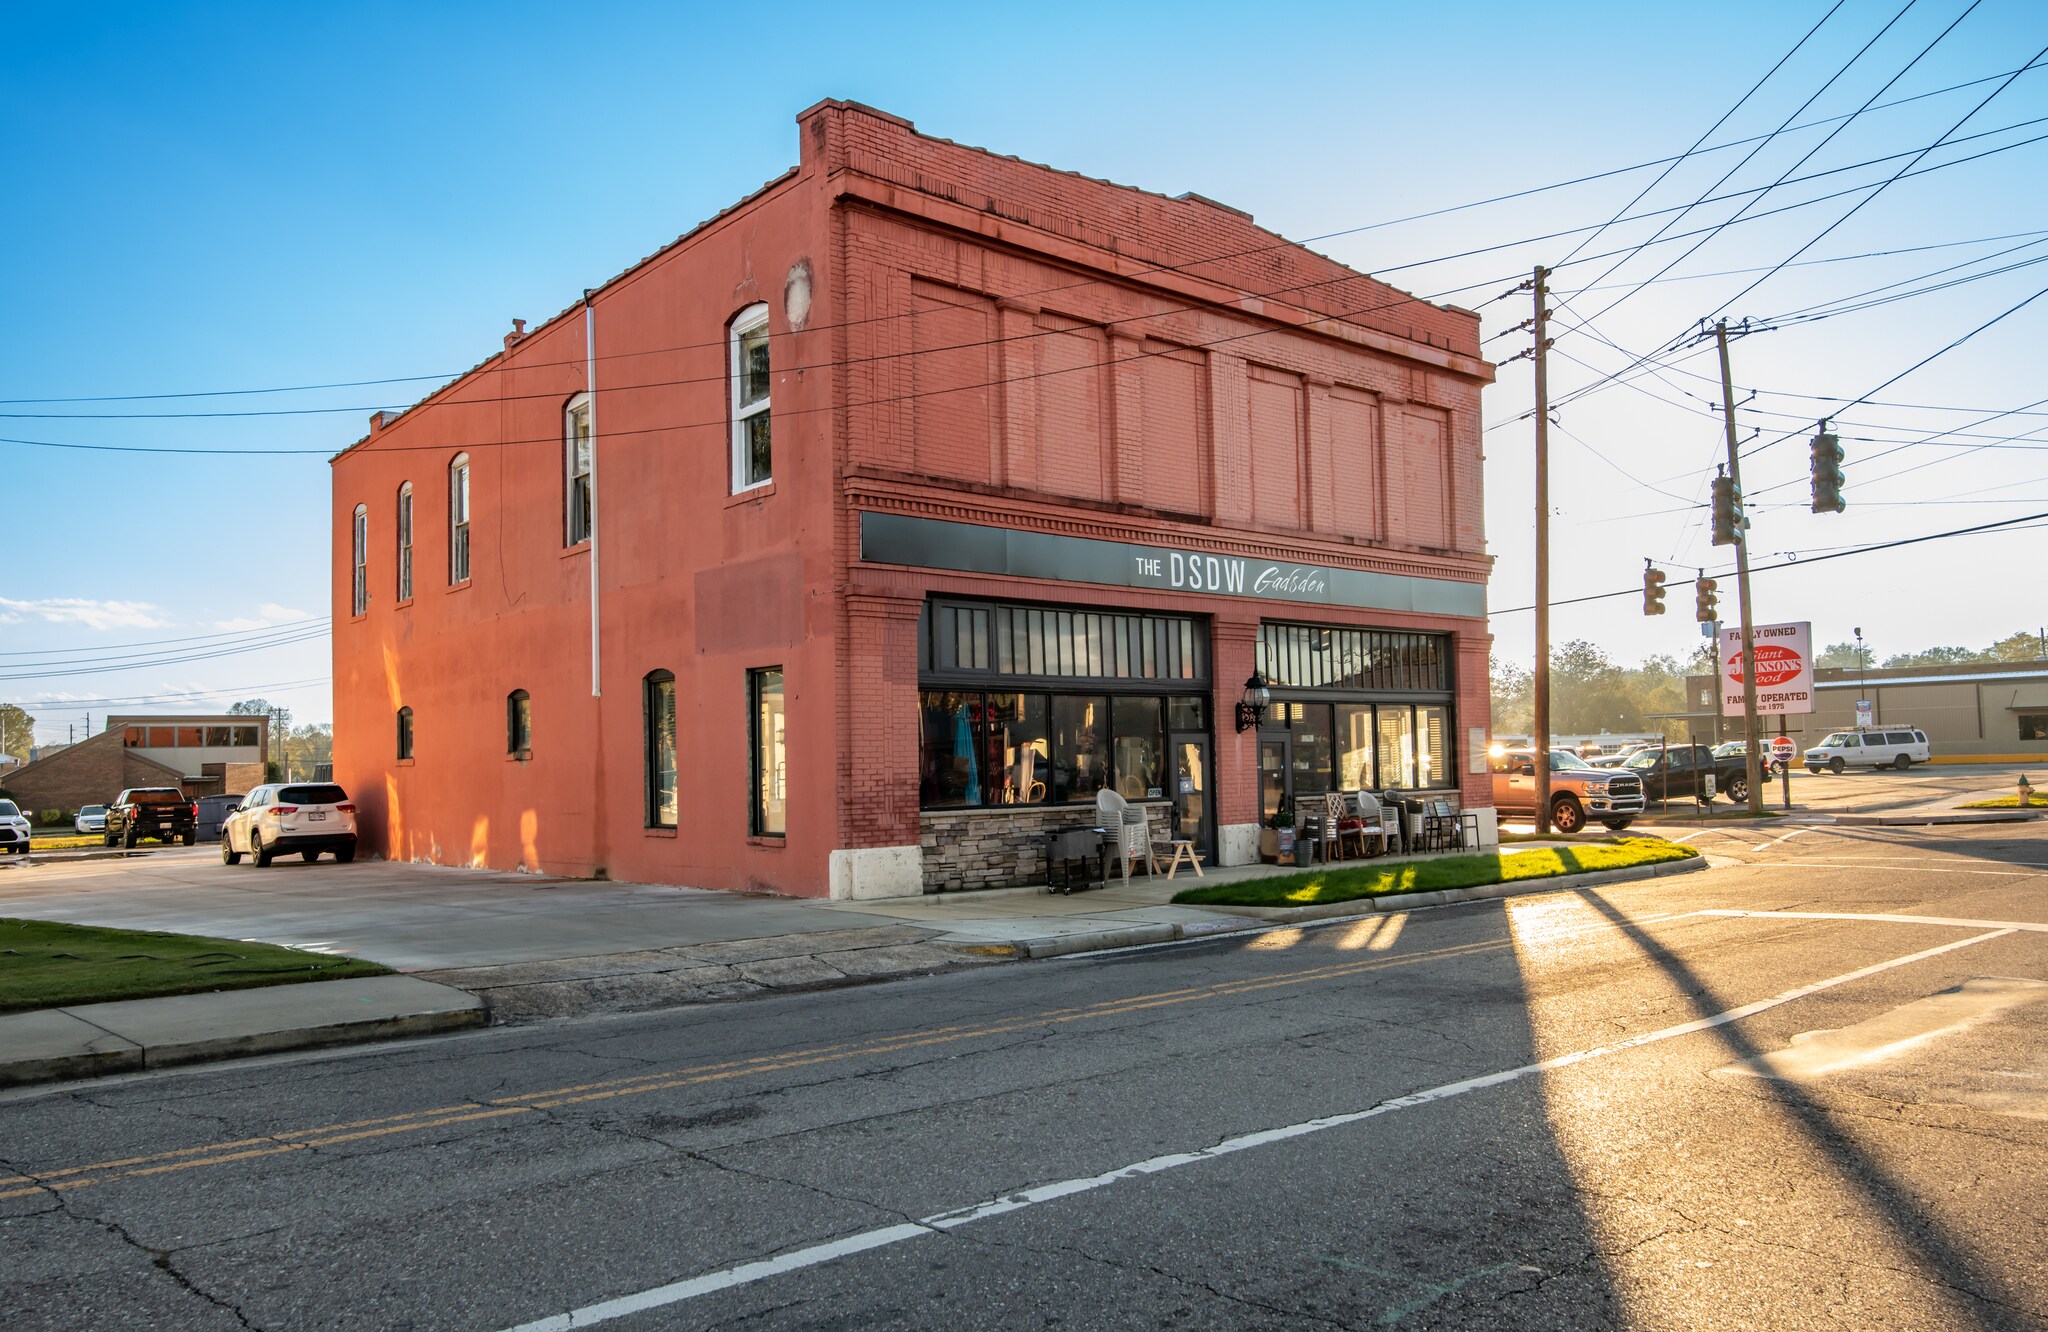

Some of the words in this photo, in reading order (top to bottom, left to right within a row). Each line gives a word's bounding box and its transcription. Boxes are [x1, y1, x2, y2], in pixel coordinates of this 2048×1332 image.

[1135, 557, 1162, 577] THE
[1170, 552, 1245, 593] DSDW
[1253, 566, 1325, 594] Gadsden
[1729, 630, 1761, 641] FALY
[1764, 627, 1796, 638] OWNED
[1730, 657, 1802, 674] JNSON'S
[1755, 671, 1786, 684] ood
[1761, 692, 1808, 702] OPERATED
